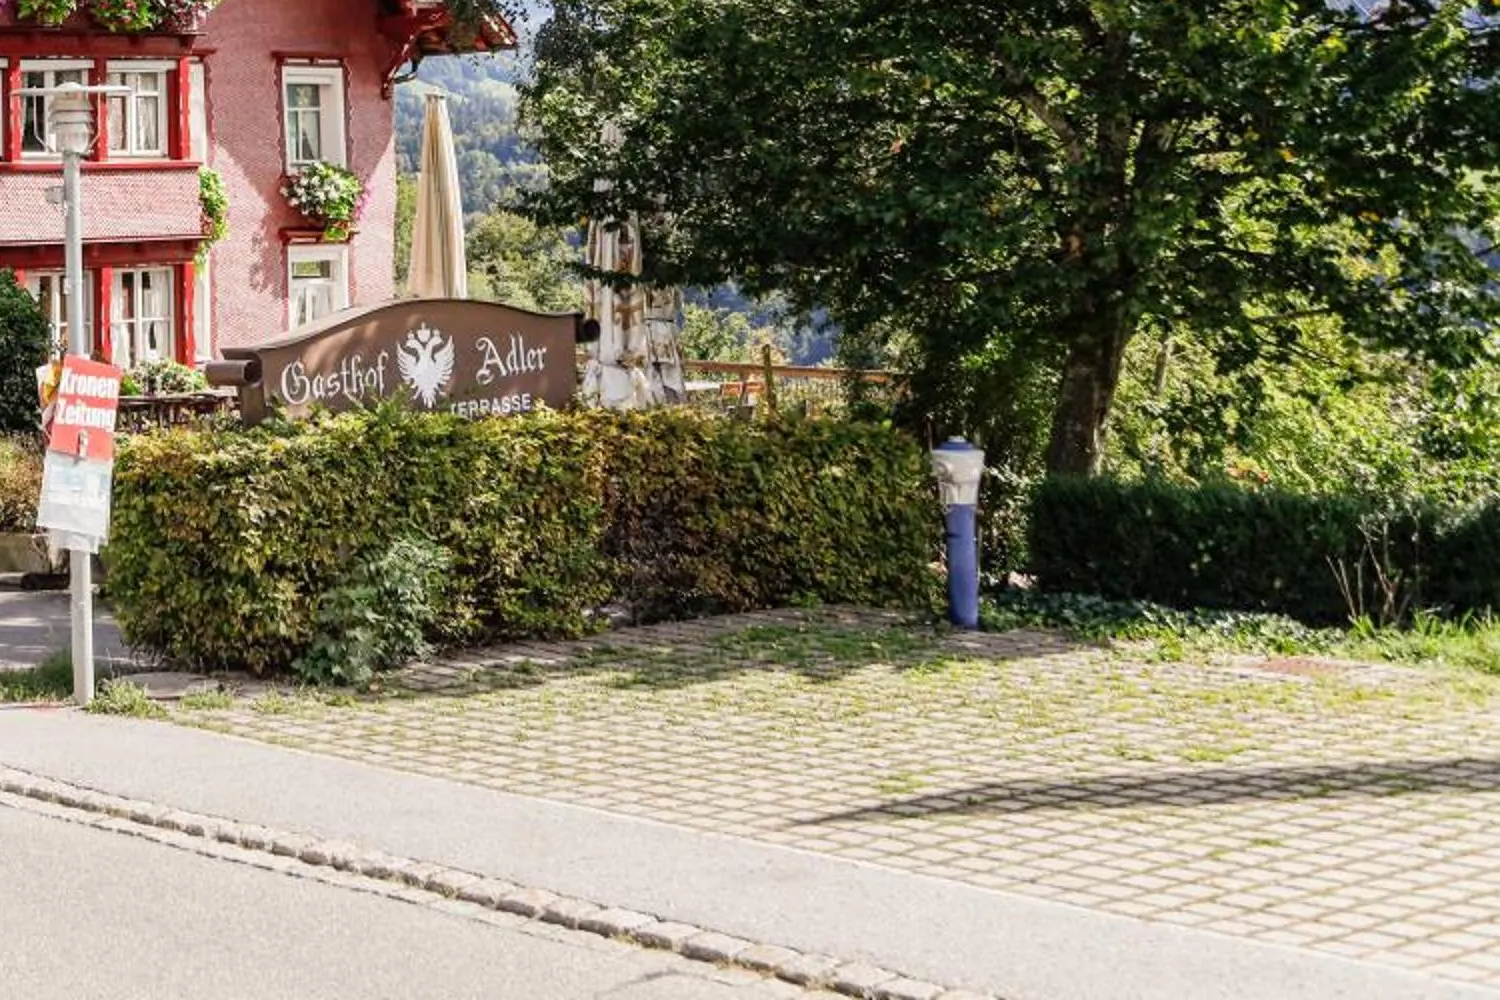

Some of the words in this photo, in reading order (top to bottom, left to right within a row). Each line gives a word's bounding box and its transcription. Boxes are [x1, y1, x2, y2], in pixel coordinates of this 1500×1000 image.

[60, 367, 120, 399] Kronen
[281, 350, 389, 406] Gasthof
[475, 333, 548, 385] Adler
[55, 398, 117, 433] Zeitung
